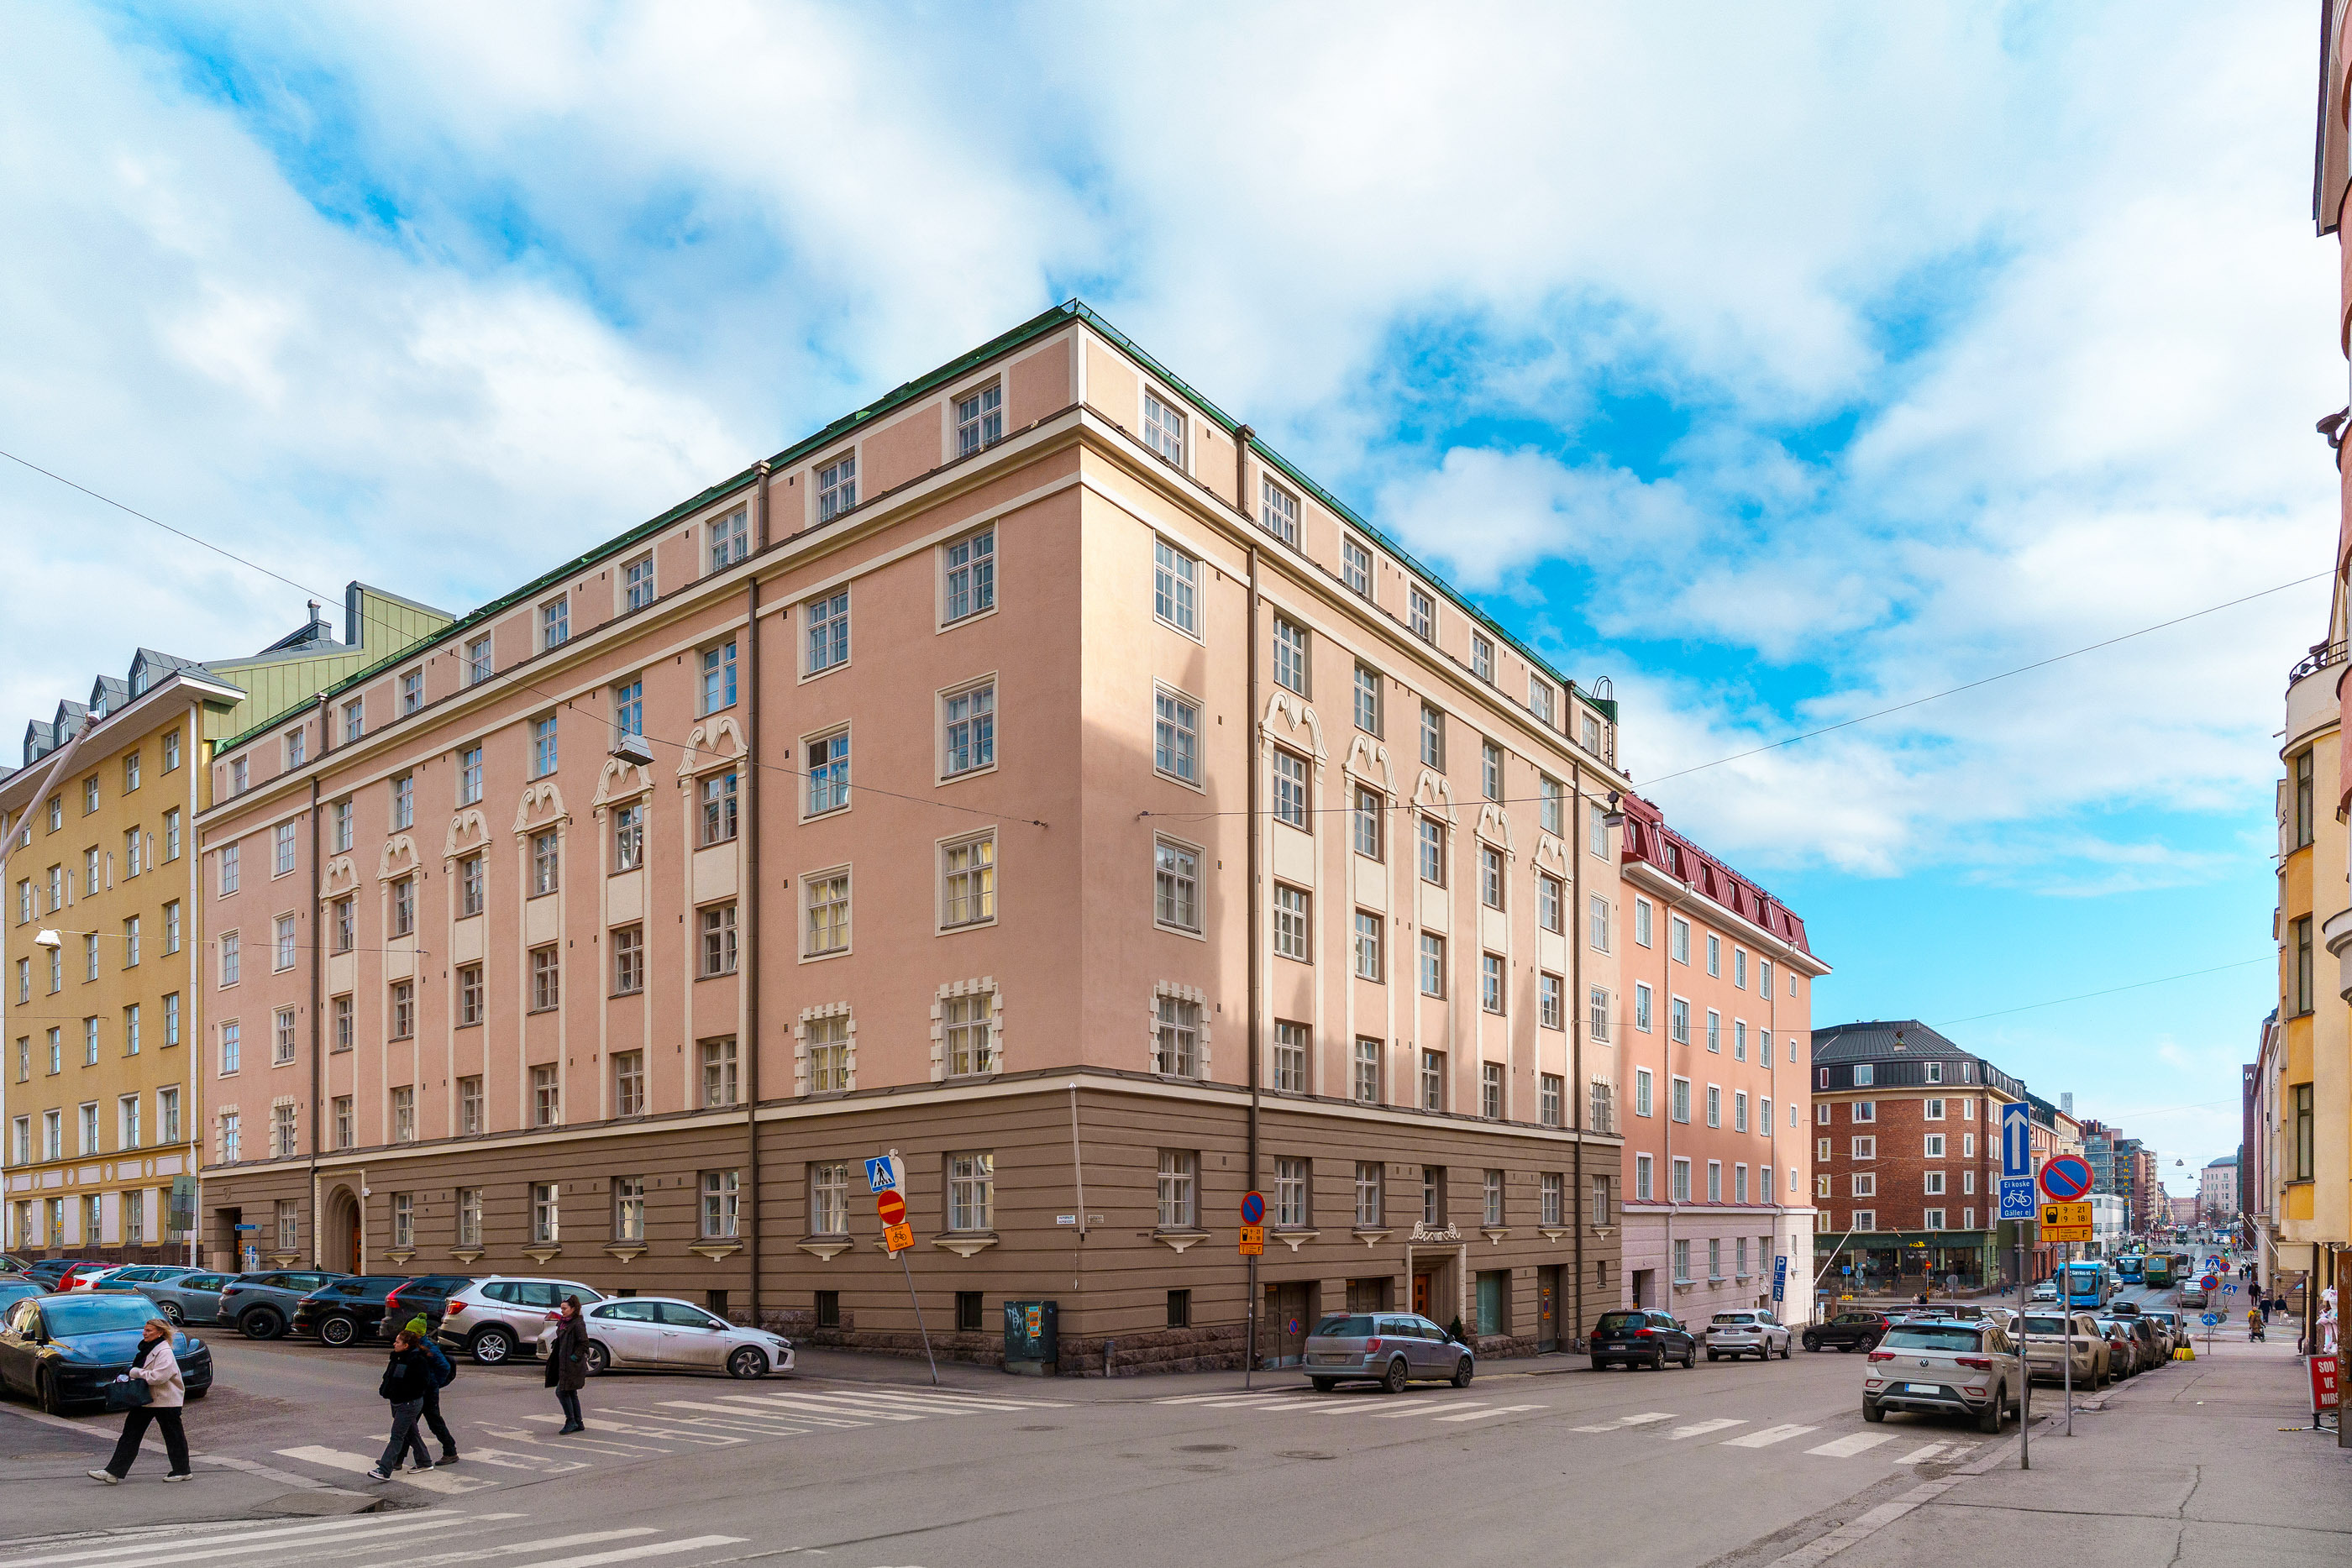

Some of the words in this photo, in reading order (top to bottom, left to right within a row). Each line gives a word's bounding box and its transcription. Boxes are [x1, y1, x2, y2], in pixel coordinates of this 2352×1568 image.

[2024, 1209, 2031, 1217] ej
[2082, 1230, 2088, 1238] F
[1777, 1257, 1785, 1270] P
[2318, 1361, 2335, 1373] SOU
[2323, 1377, 2334, 1388] VE
